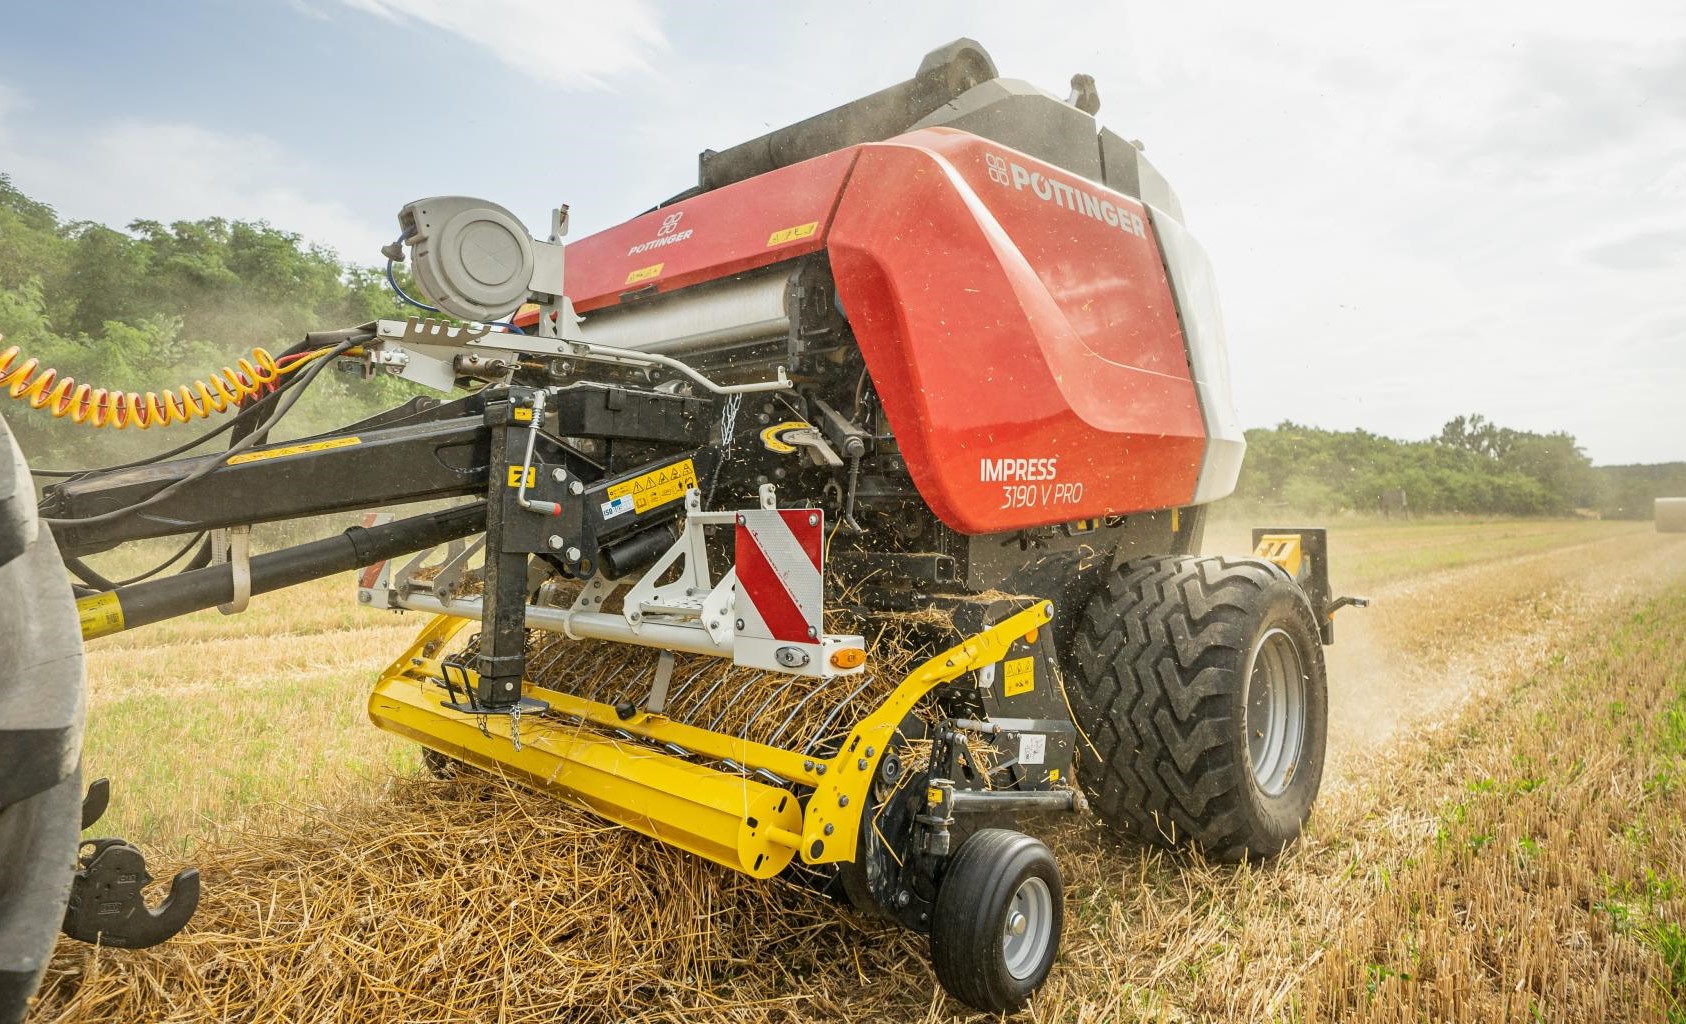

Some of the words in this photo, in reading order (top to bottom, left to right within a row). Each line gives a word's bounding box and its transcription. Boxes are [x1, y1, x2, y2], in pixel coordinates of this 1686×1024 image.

[980, 458, 1057, 481] IMPRESS
[1001, 485, 1037, 509] 3190
[1041, 484, 1053, 506] V
[1053, 482, 1083, 505] PRO
